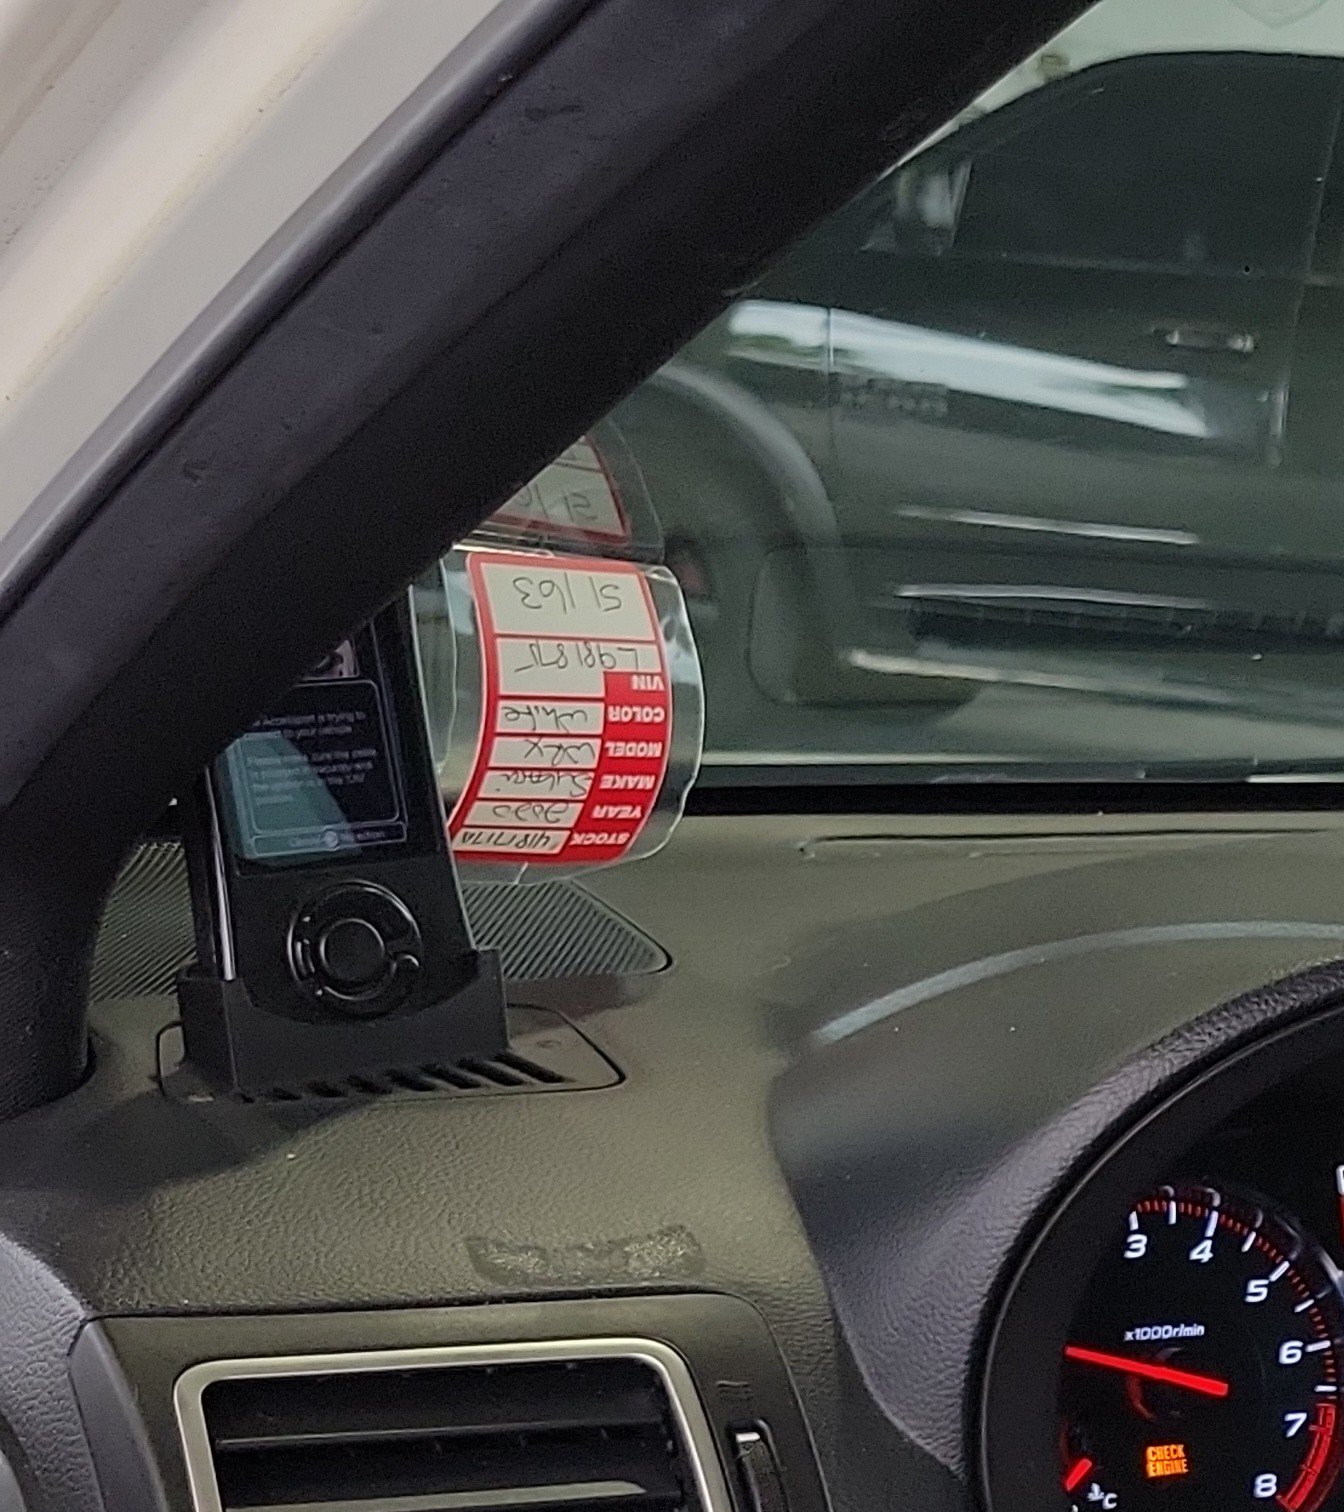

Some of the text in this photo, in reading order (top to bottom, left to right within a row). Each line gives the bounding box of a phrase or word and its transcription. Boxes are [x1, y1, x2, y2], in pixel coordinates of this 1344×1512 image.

[632, 674, 665, 691] VIN
[607, 706, 666, 724] COLOR
[524, 738, 596, 766] WRX
[604, 741, 664, 758] MODEL
[599, 773, 657, 790] MAKE
[492, 800, 571, 824] 2020
[591, 804, 642, 819] YEAR
[570, 831, 632, 846] STOCK
[1123, 1233, 1148, 1259] 3
[1188, 1240, 1214, 1264] 4
[1244, 1279, 1270, 1303] 5
[1123, 1323, 1206, 1342] x1000r/min
[1278, 1340, 1304, 1365] 6
[1283, 1412, 1308, 1438] 7
[1147, 1444, 1186, 1461] CHECK
[1147, 1459, 1189, 1478] ENGINE
[1252, 1473, 1278, 1499] 8
[1102, 1492, 1118, 1510] C
